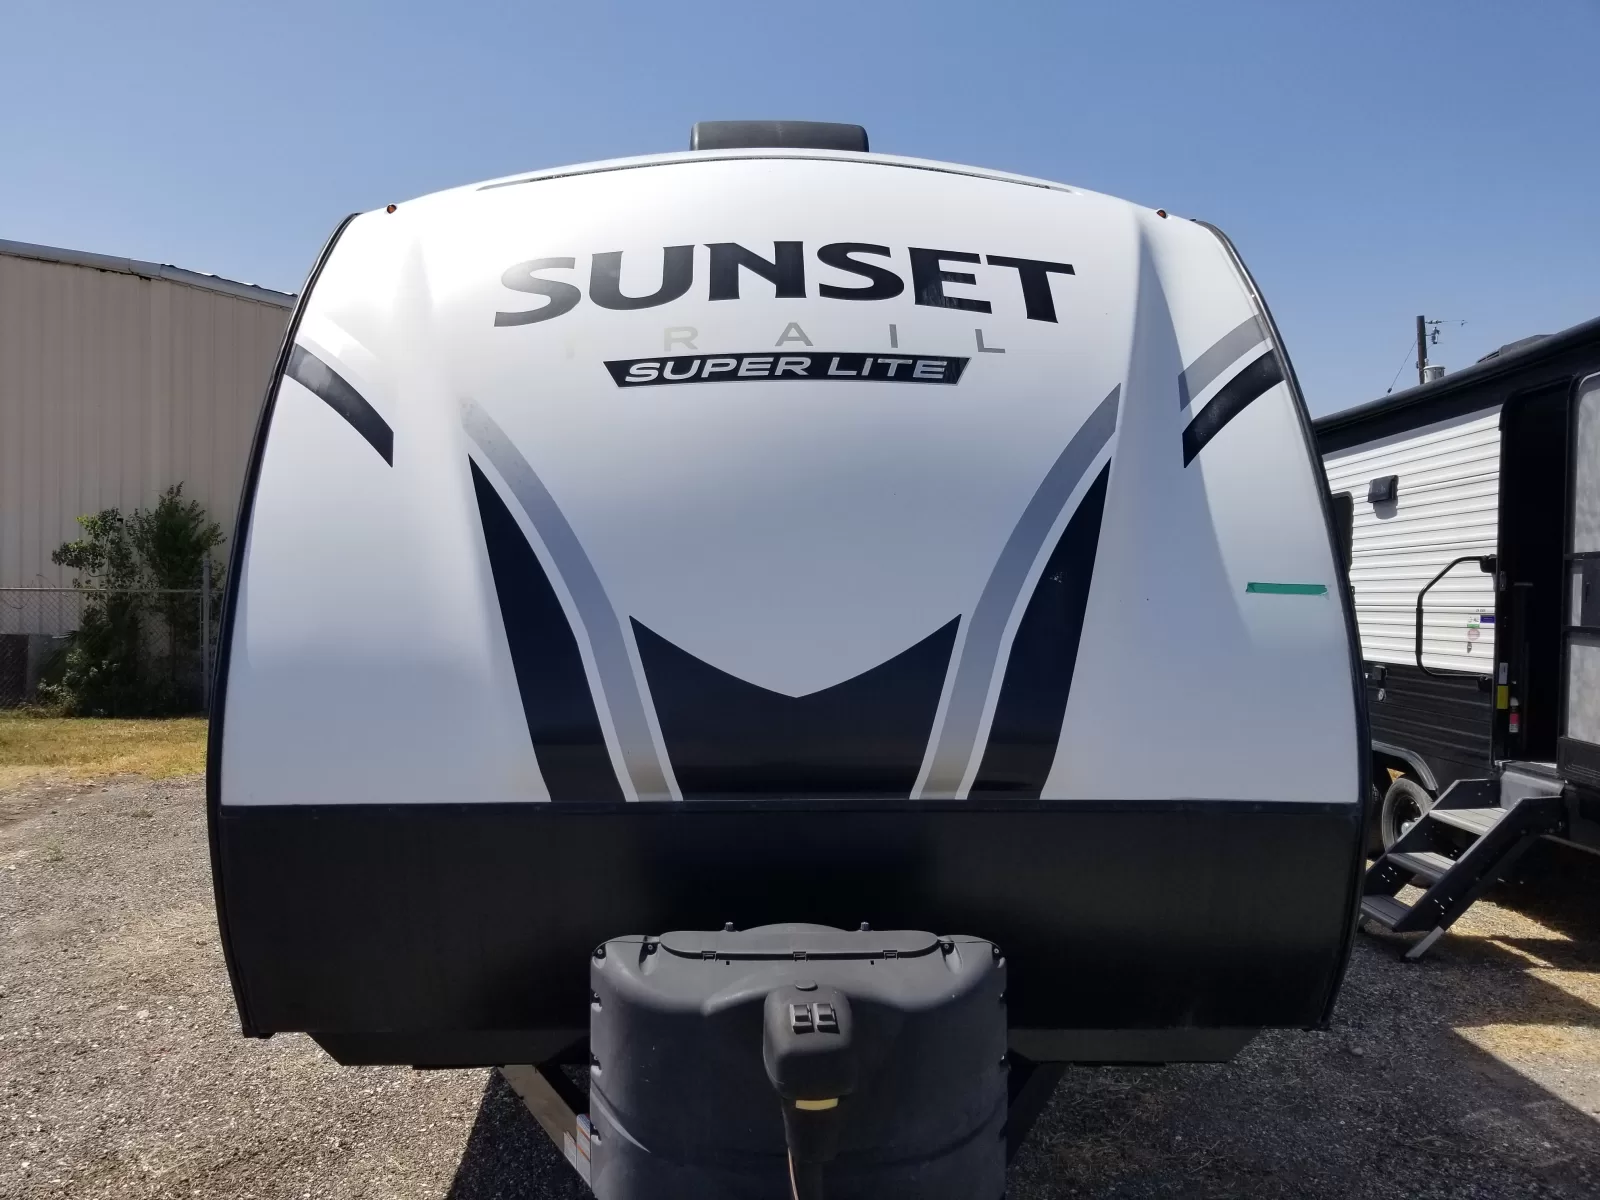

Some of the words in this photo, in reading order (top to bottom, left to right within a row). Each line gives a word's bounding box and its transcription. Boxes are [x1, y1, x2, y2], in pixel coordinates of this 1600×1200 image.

[494, 241, 1075, 327] SUNSET
[624, 357, 811, 383] SUPER
[826, 357, 948, 381] LITE
